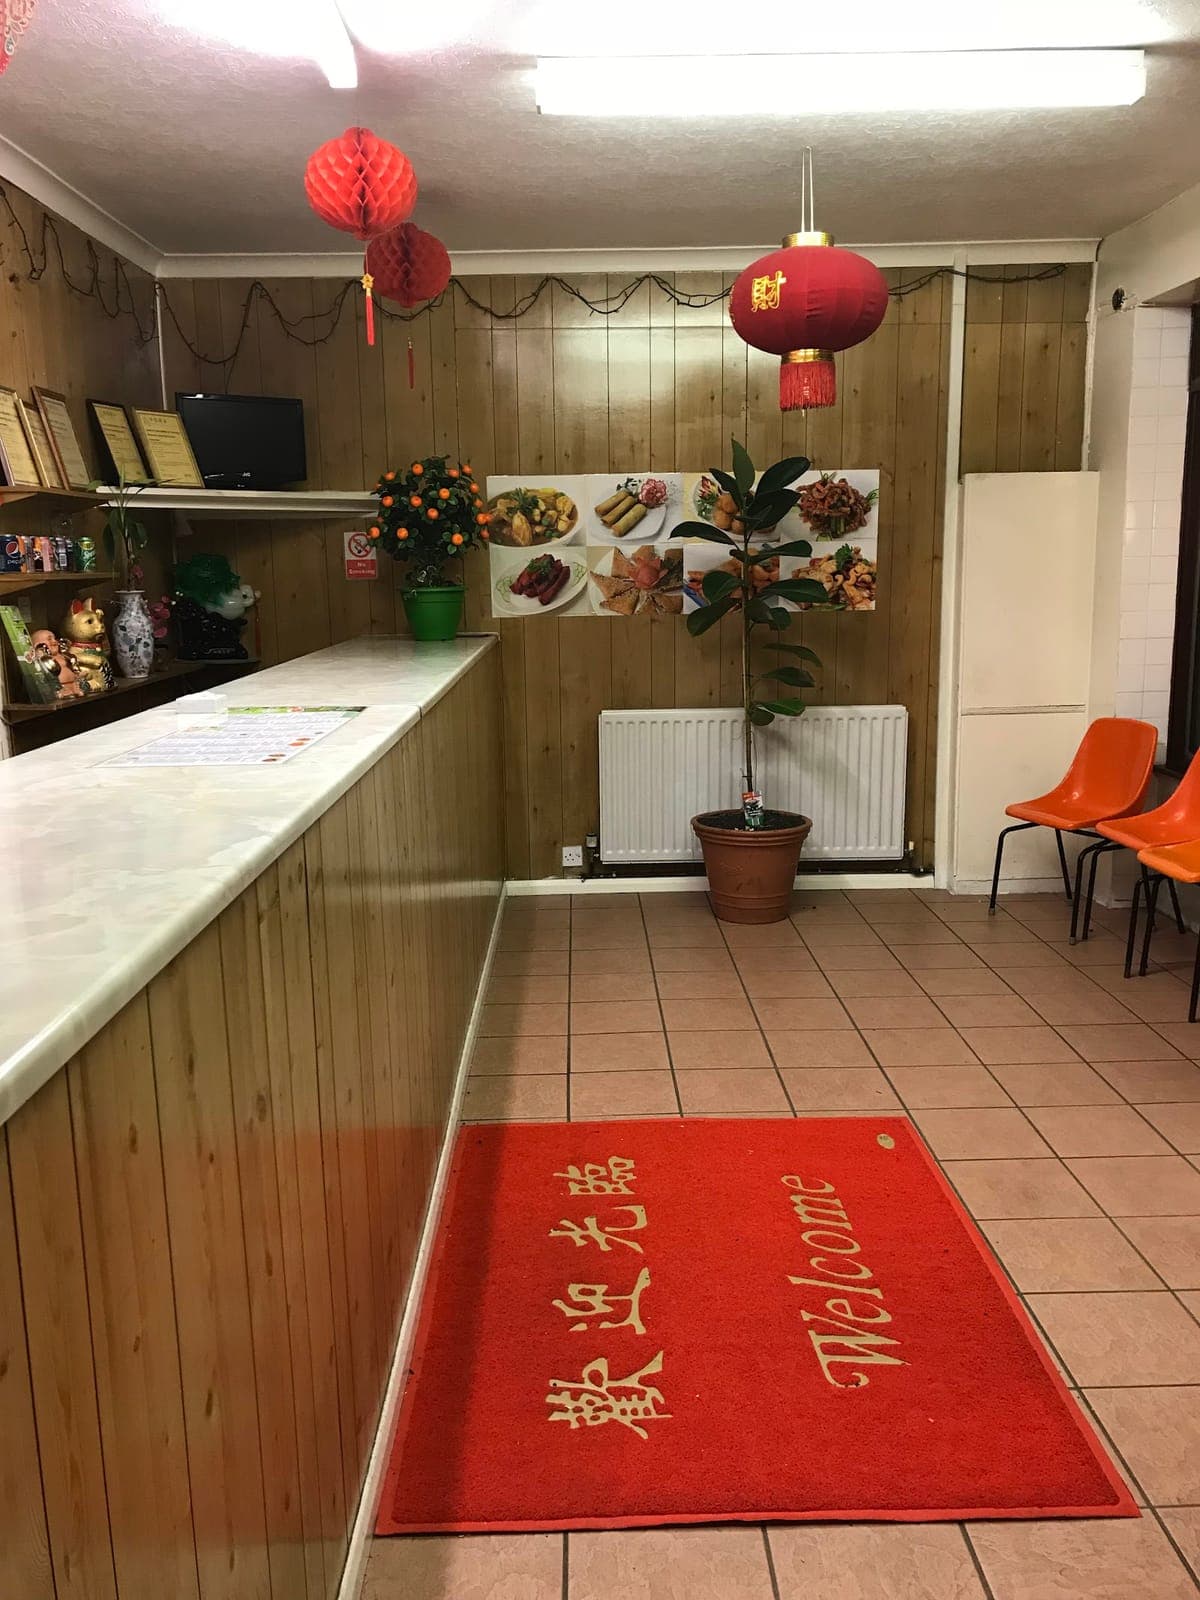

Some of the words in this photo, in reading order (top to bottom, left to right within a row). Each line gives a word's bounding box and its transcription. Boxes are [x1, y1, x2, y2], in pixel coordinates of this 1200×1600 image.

[750, 270, 787, 313] 財
[545, 1155, 674, 1440] 歡迎光臨
[780, 1174, 912, 1389] Welcome
